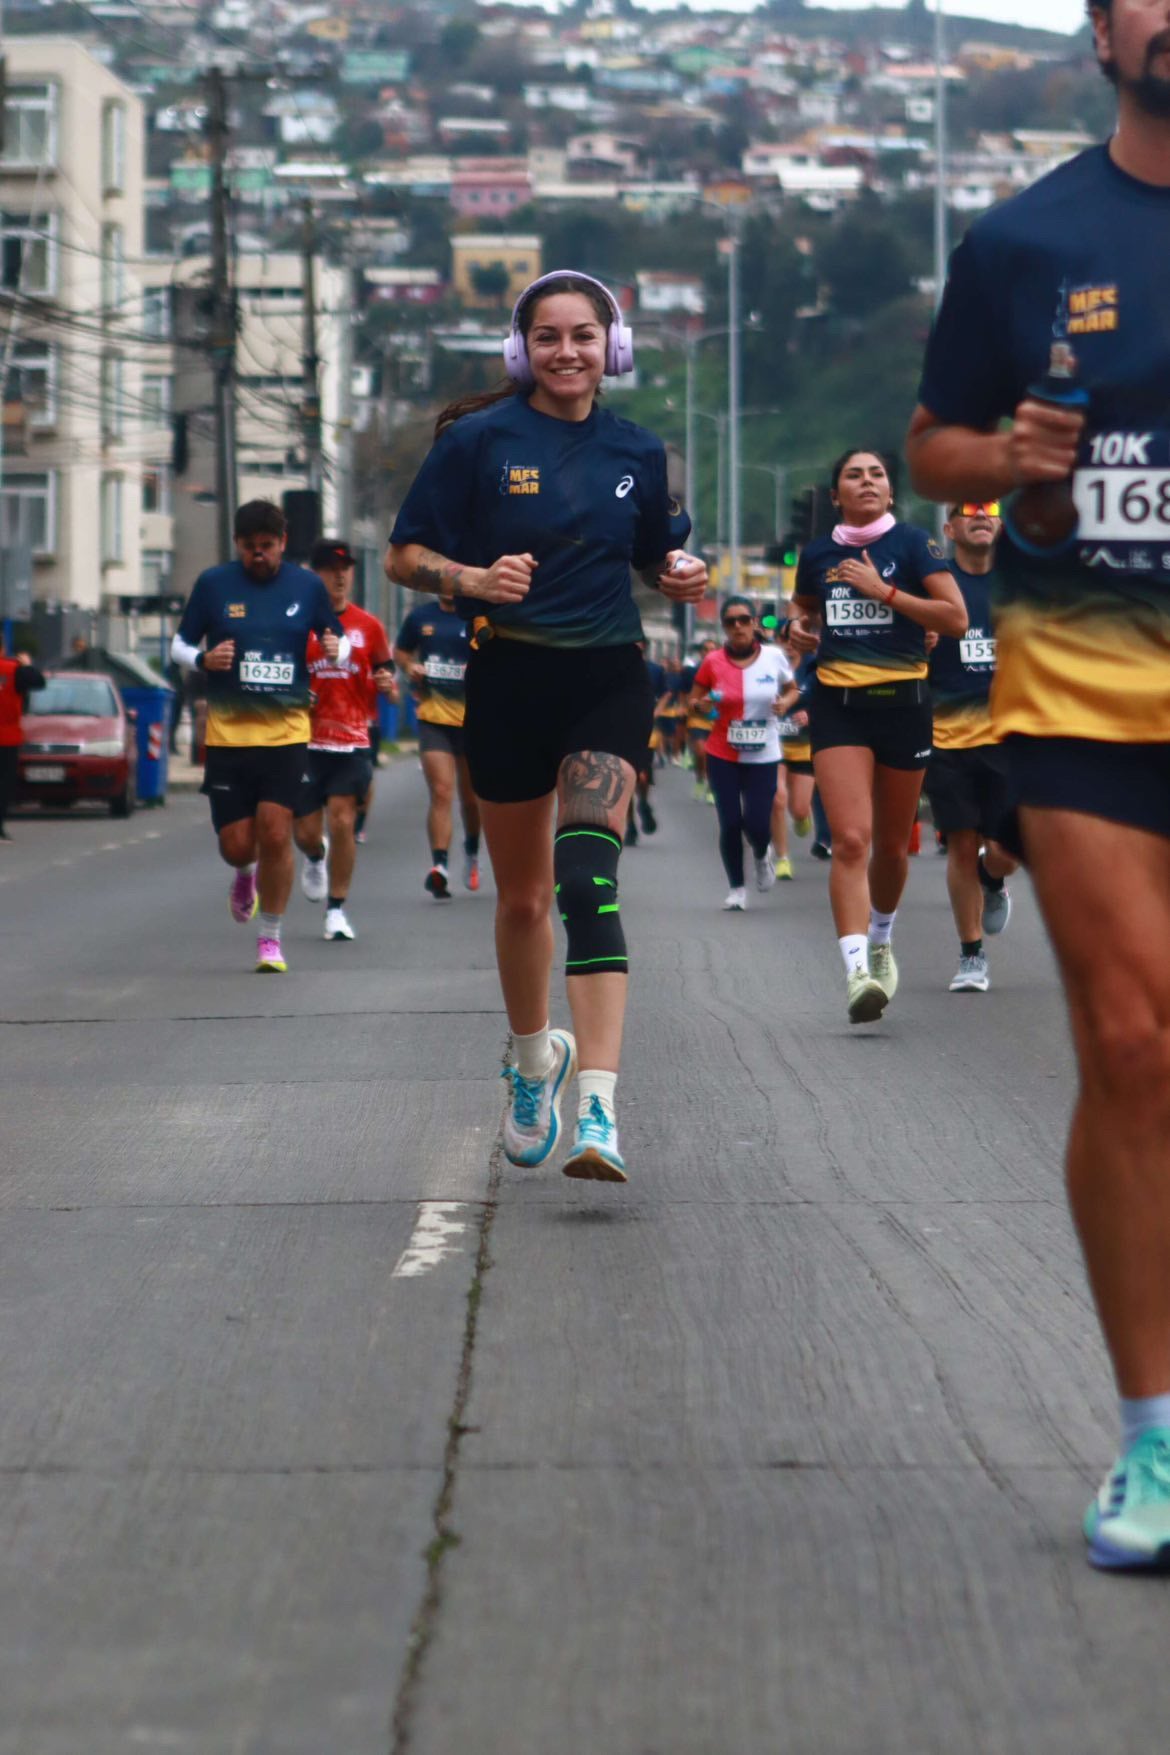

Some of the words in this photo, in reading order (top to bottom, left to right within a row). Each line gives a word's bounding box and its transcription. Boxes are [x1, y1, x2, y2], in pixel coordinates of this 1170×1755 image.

[1066, 309, 1116, 334] MAR
[1089, 432, 1152, 465] 10K
[509, 482, 540, 494] MAR
[831, 587, 851, 599] 10K
[831, 602, 889, 620] 15805
[243, 664, 291, 679] 16236
